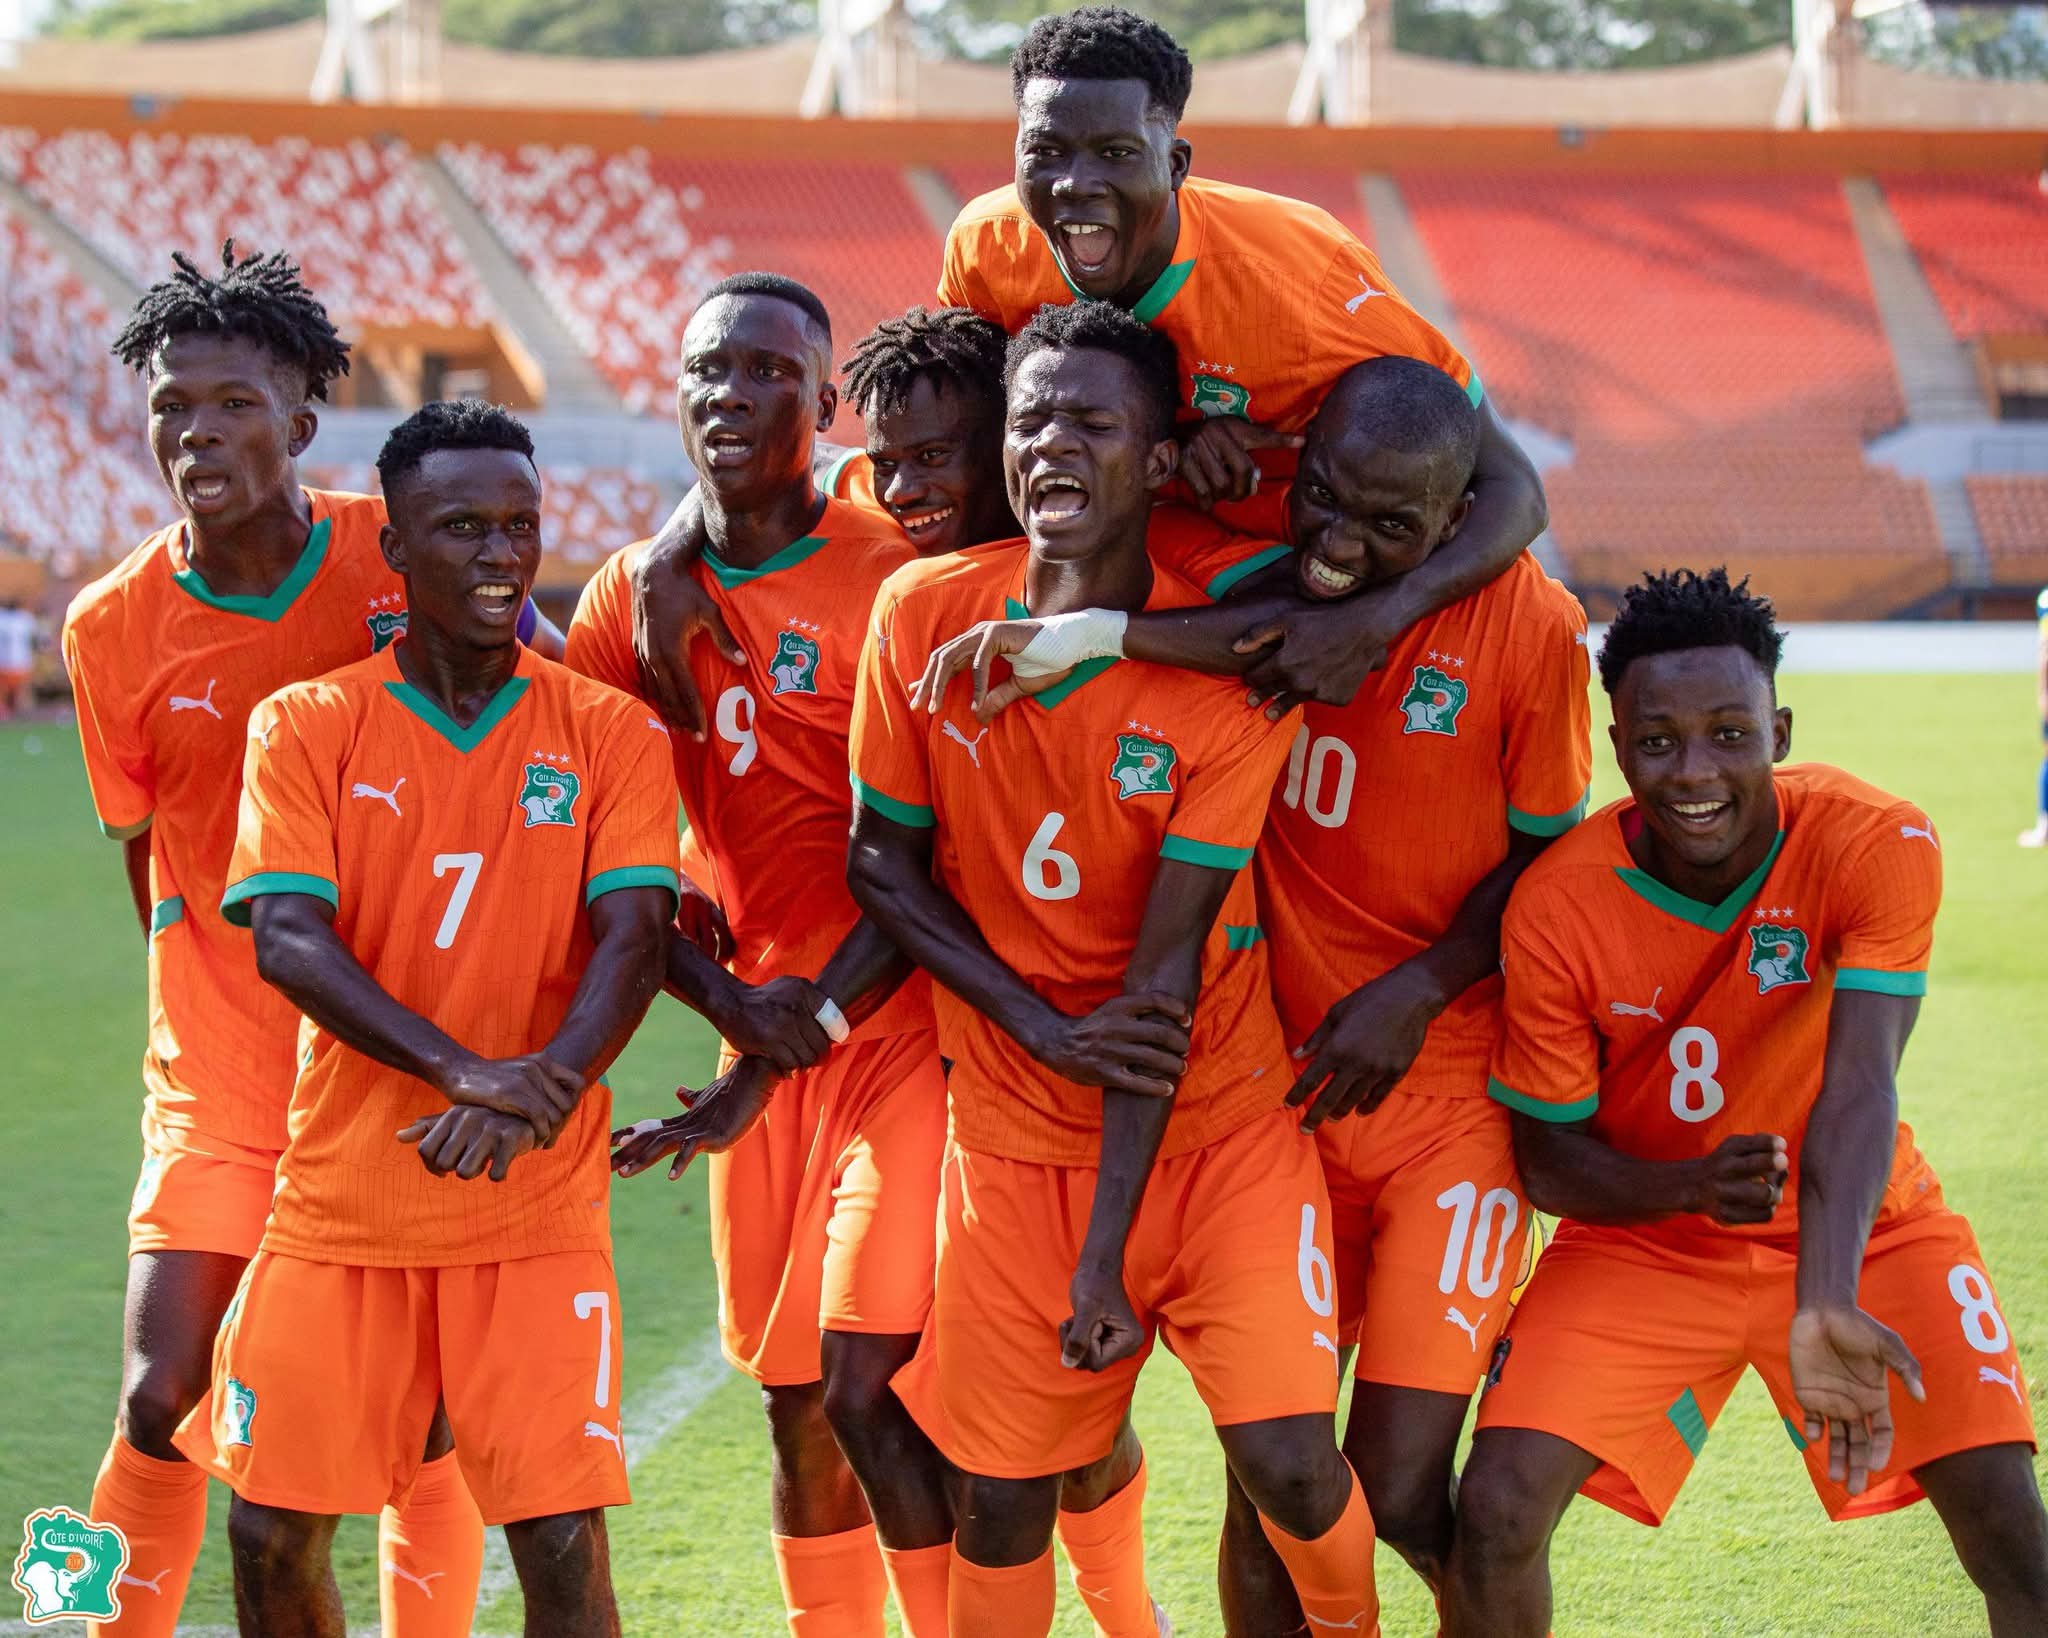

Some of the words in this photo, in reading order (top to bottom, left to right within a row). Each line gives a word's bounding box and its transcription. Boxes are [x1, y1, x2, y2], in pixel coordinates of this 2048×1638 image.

[716, 686, 758, 776] 9
[1283, 722, 1357, 828] 10
[432, 851, 484, 950] 7
[1022, 811, 1081, 902] 6
[1669, 1026, 1725, 1123] 8
[1297, 1203, 1333, 1318] 6
[1436, 1180, 1519, 1299] 10
[573, 1291, 612, 1409] 7
[1947, 1263, 2011, 1355] 8
